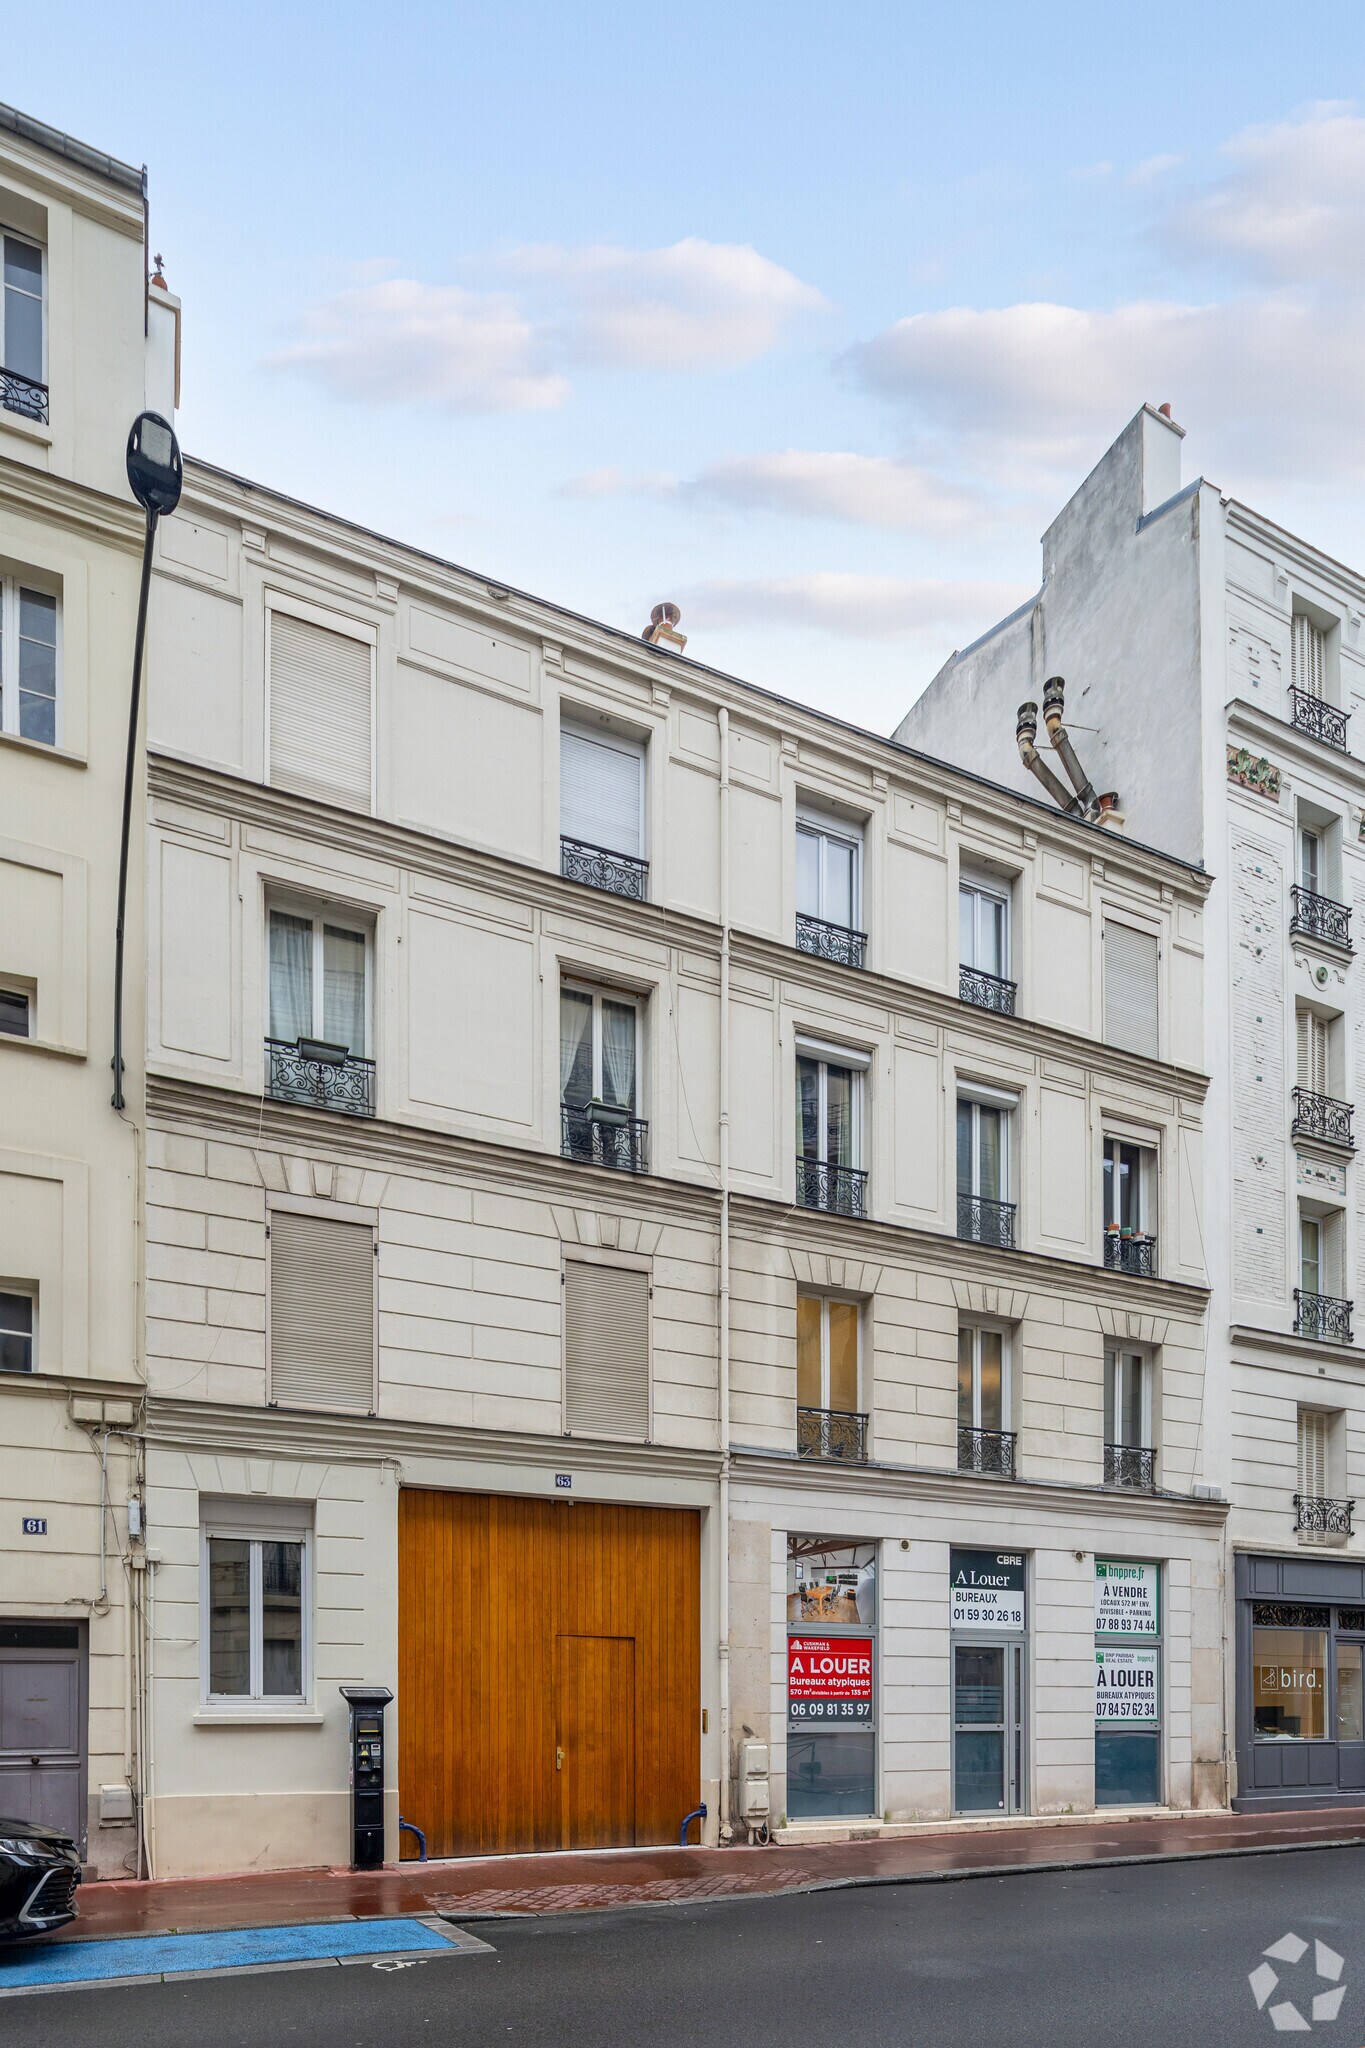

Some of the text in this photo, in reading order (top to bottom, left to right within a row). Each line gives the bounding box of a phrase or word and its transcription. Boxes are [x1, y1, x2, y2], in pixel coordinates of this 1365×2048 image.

[556, 1476, 570, 1486] 63
[26, 1520, 43, 1532] 61
[996, 1555, 1022, 1566] CBRE
[955, 1570, 1010, 1586] A Louer
[1109, 1565, 1144, 1581] bnppre.fr
[1104, 1583, 1147, 1598] À VENDRE
[956, 1592, 997, 1603] BUREAUX
[954, 1609, 1021, 1622] 01 59 30 26 18
[1096, 1618, 1155, 1631] 07 88 93 74 44
[791, 1657, 870, 1674] A LOUER
[790, 1677, 870, 1687] Bureaux atypiques
[1097, 1666, 1154, 1687] À LOUER
[1281, 1668, 1322, 1688] bird.
[791, 1703, 870, 1715] 06 09 81 35 97
[1097, 1703, 1154, 1715] 07 84 57 62 34
